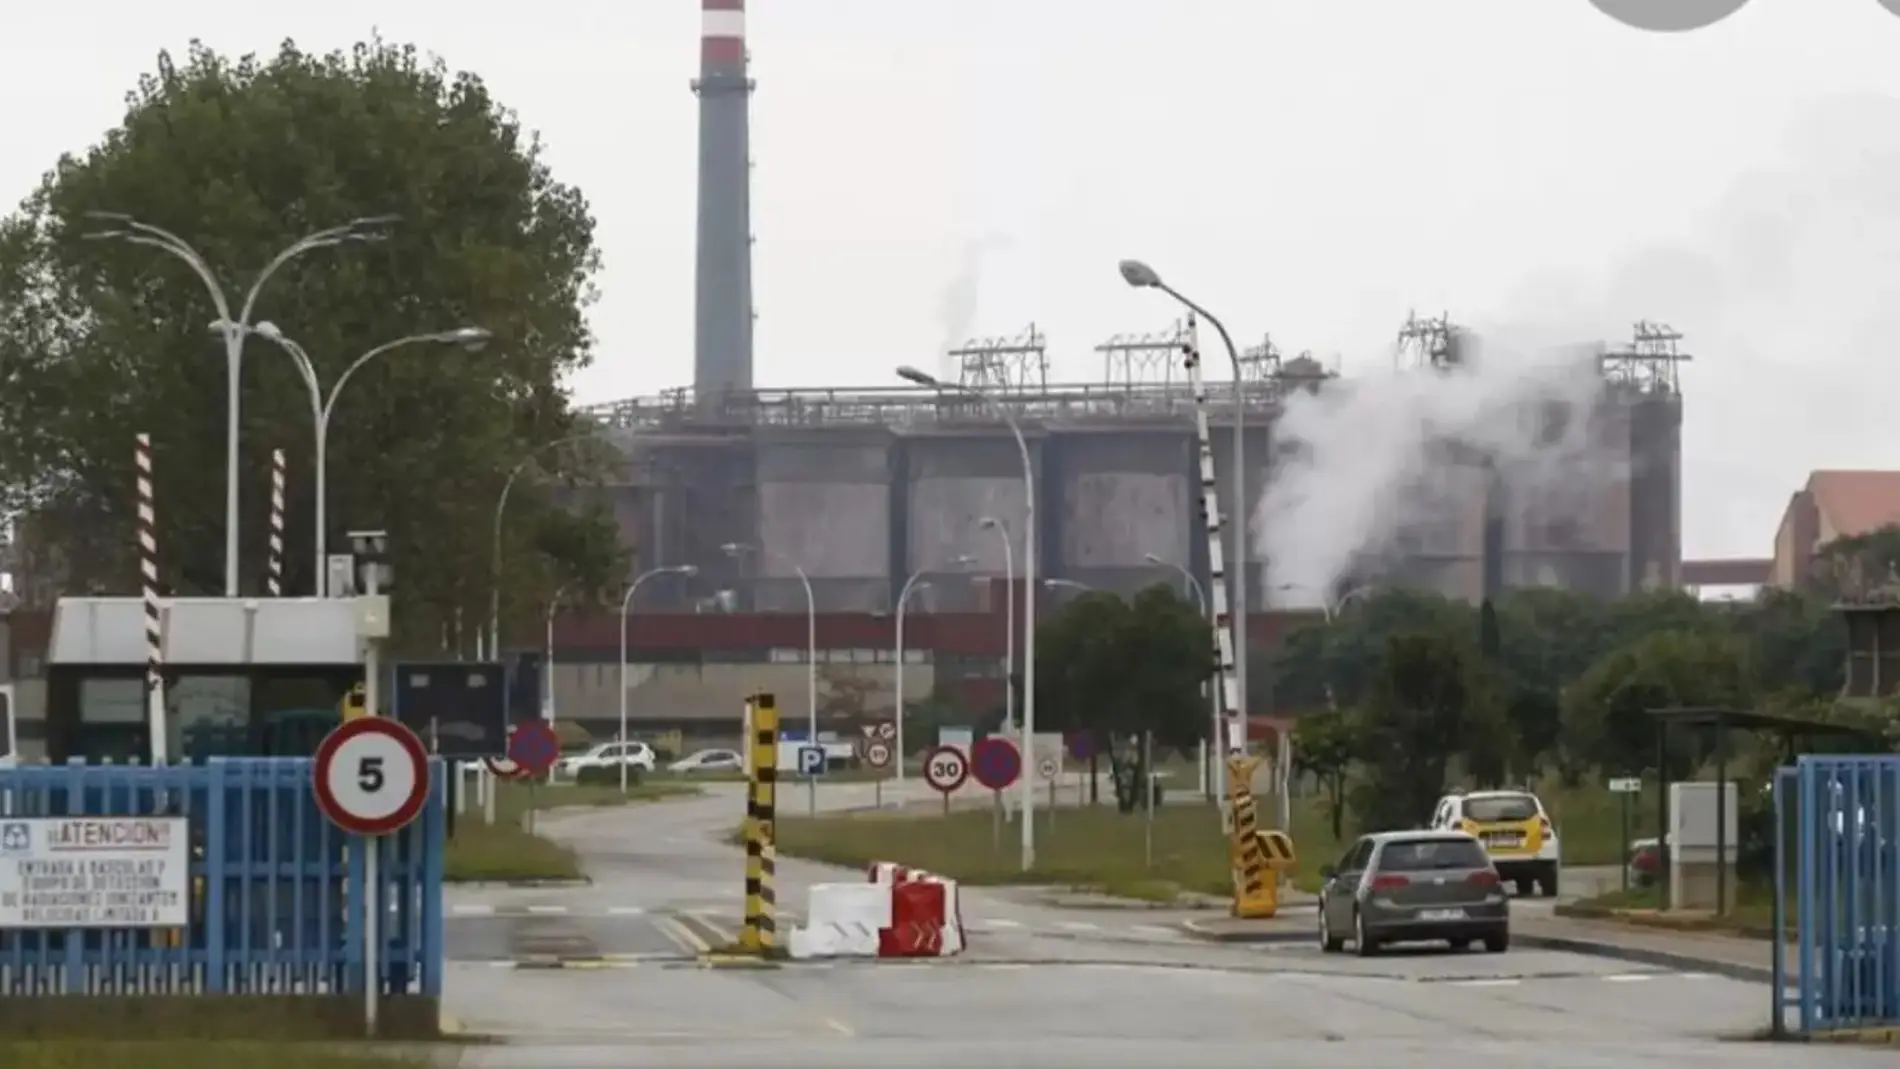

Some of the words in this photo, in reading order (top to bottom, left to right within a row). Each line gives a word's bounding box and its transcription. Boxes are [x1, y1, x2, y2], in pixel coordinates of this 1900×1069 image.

[802, 749, 821, 773] P
[933, 762, 959, 778] 30
[358, 757, 384, 792] 5
